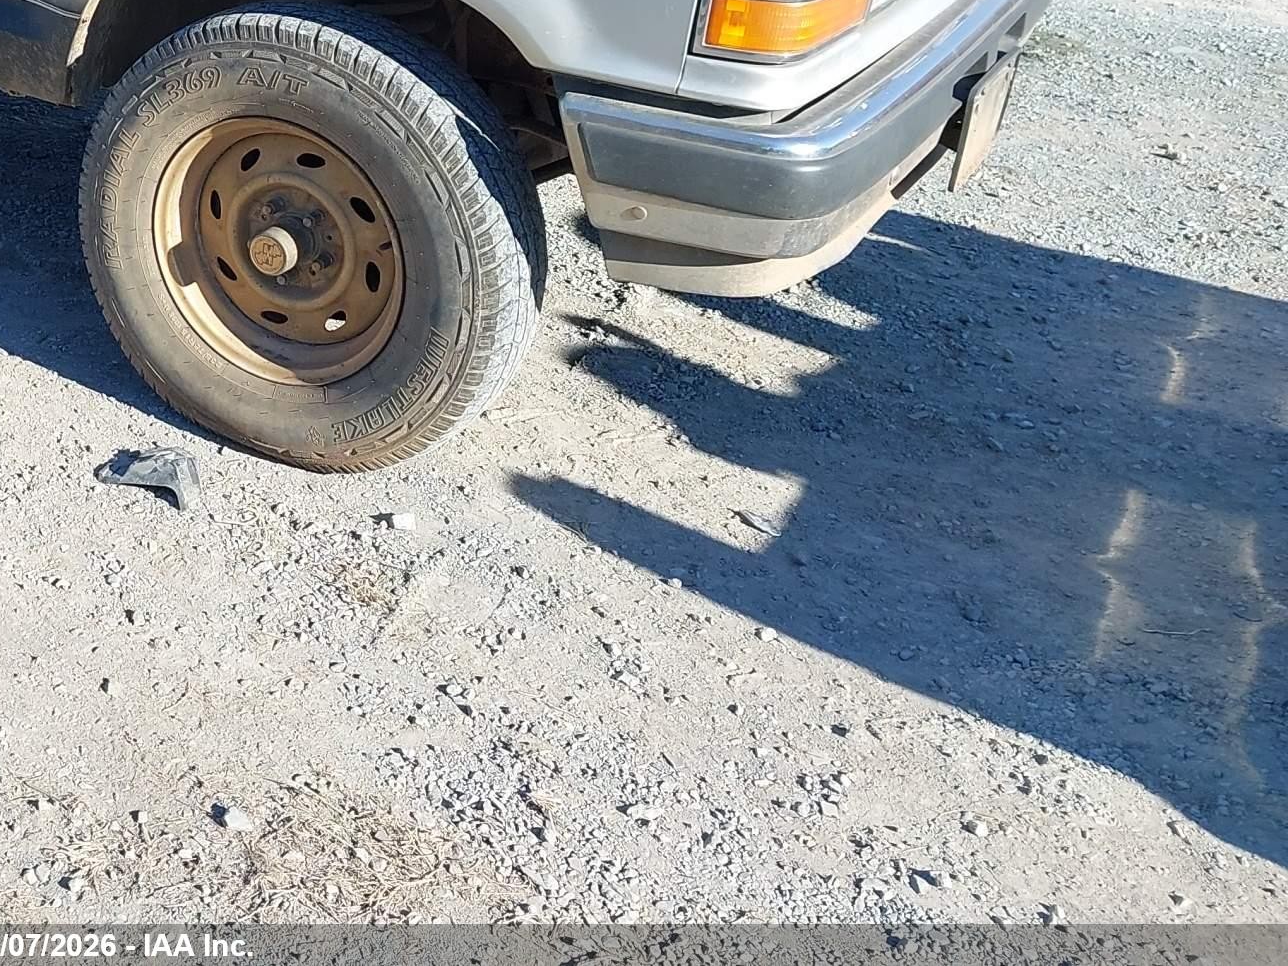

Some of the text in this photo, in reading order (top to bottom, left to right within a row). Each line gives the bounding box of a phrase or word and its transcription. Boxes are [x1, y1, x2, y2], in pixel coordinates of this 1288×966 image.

[98, 129, 140, 270] RADIAL
[136, 66, 223, 127] SL369
[238, 66, 309, 96] A/T
[332, 326, 450, 445] WESTLAKE
